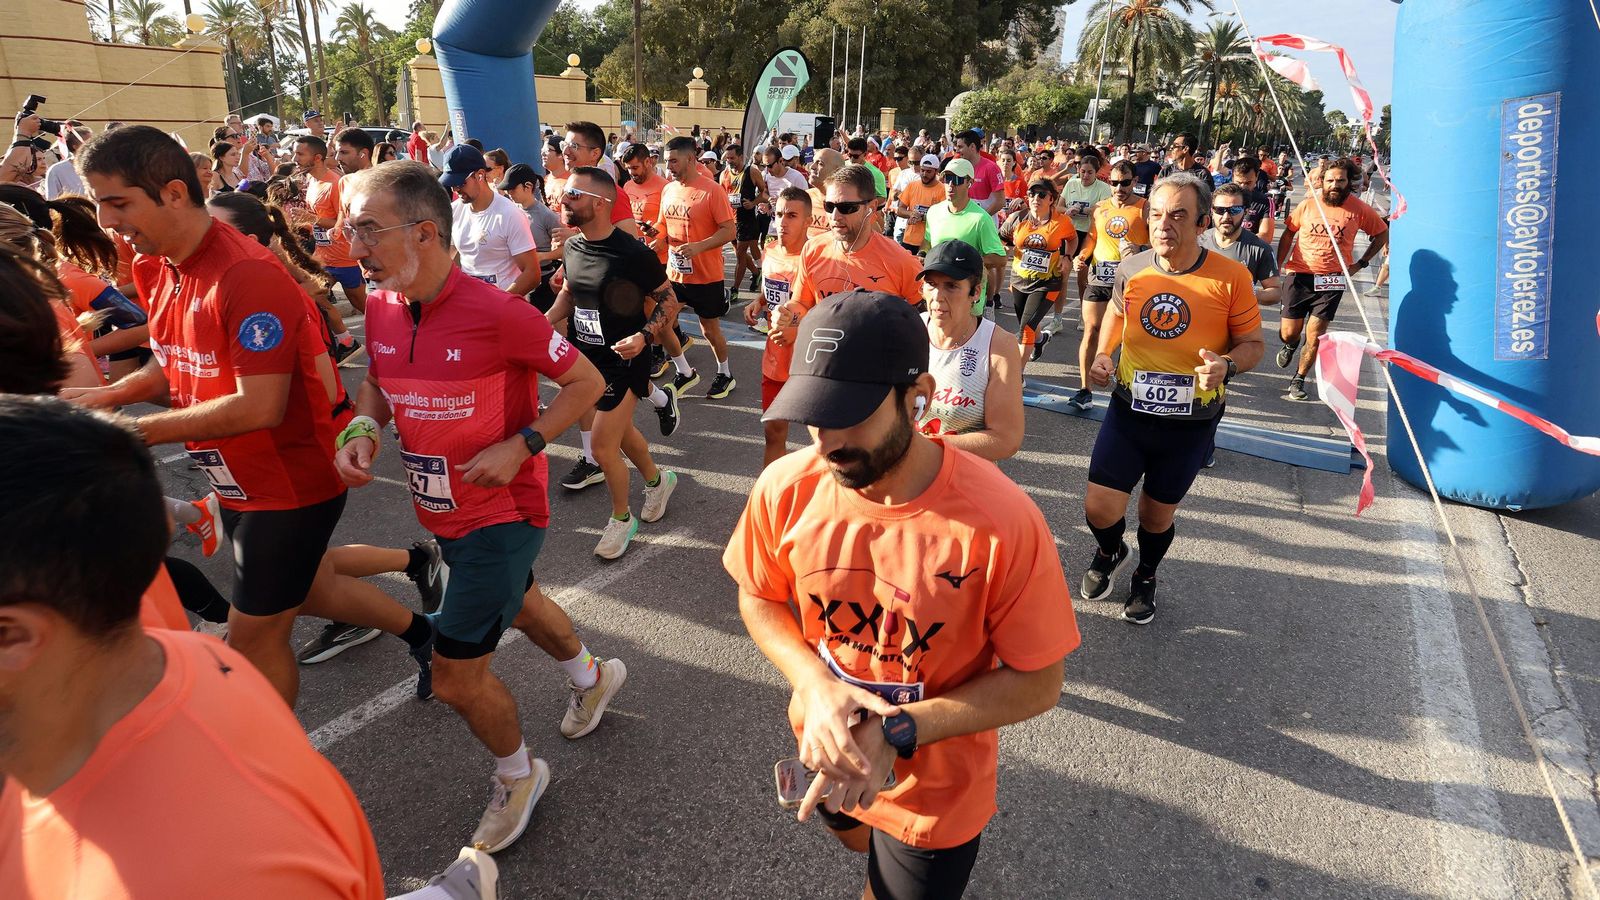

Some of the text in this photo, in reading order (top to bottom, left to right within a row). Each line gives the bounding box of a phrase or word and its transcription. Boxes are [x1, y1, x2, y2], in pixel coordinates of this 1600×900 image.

[768, 87, 795, 95] SPORT
[1506, 103, 1552, 353] deportes@aytojerez.es
[1028, 257, 1043, 265] 628
[1103, 268, 1115, 276] 63
[1153, 294, 1182, 306] BEER
[1142, 317, 1187, 338] RUNNERS
[390, 391, 475, 410] muebles miguel
[933, 387, 976, 408] atón
[1146, 386, 1178, 402] 602
[437, 410, 467, 420] sidonia
